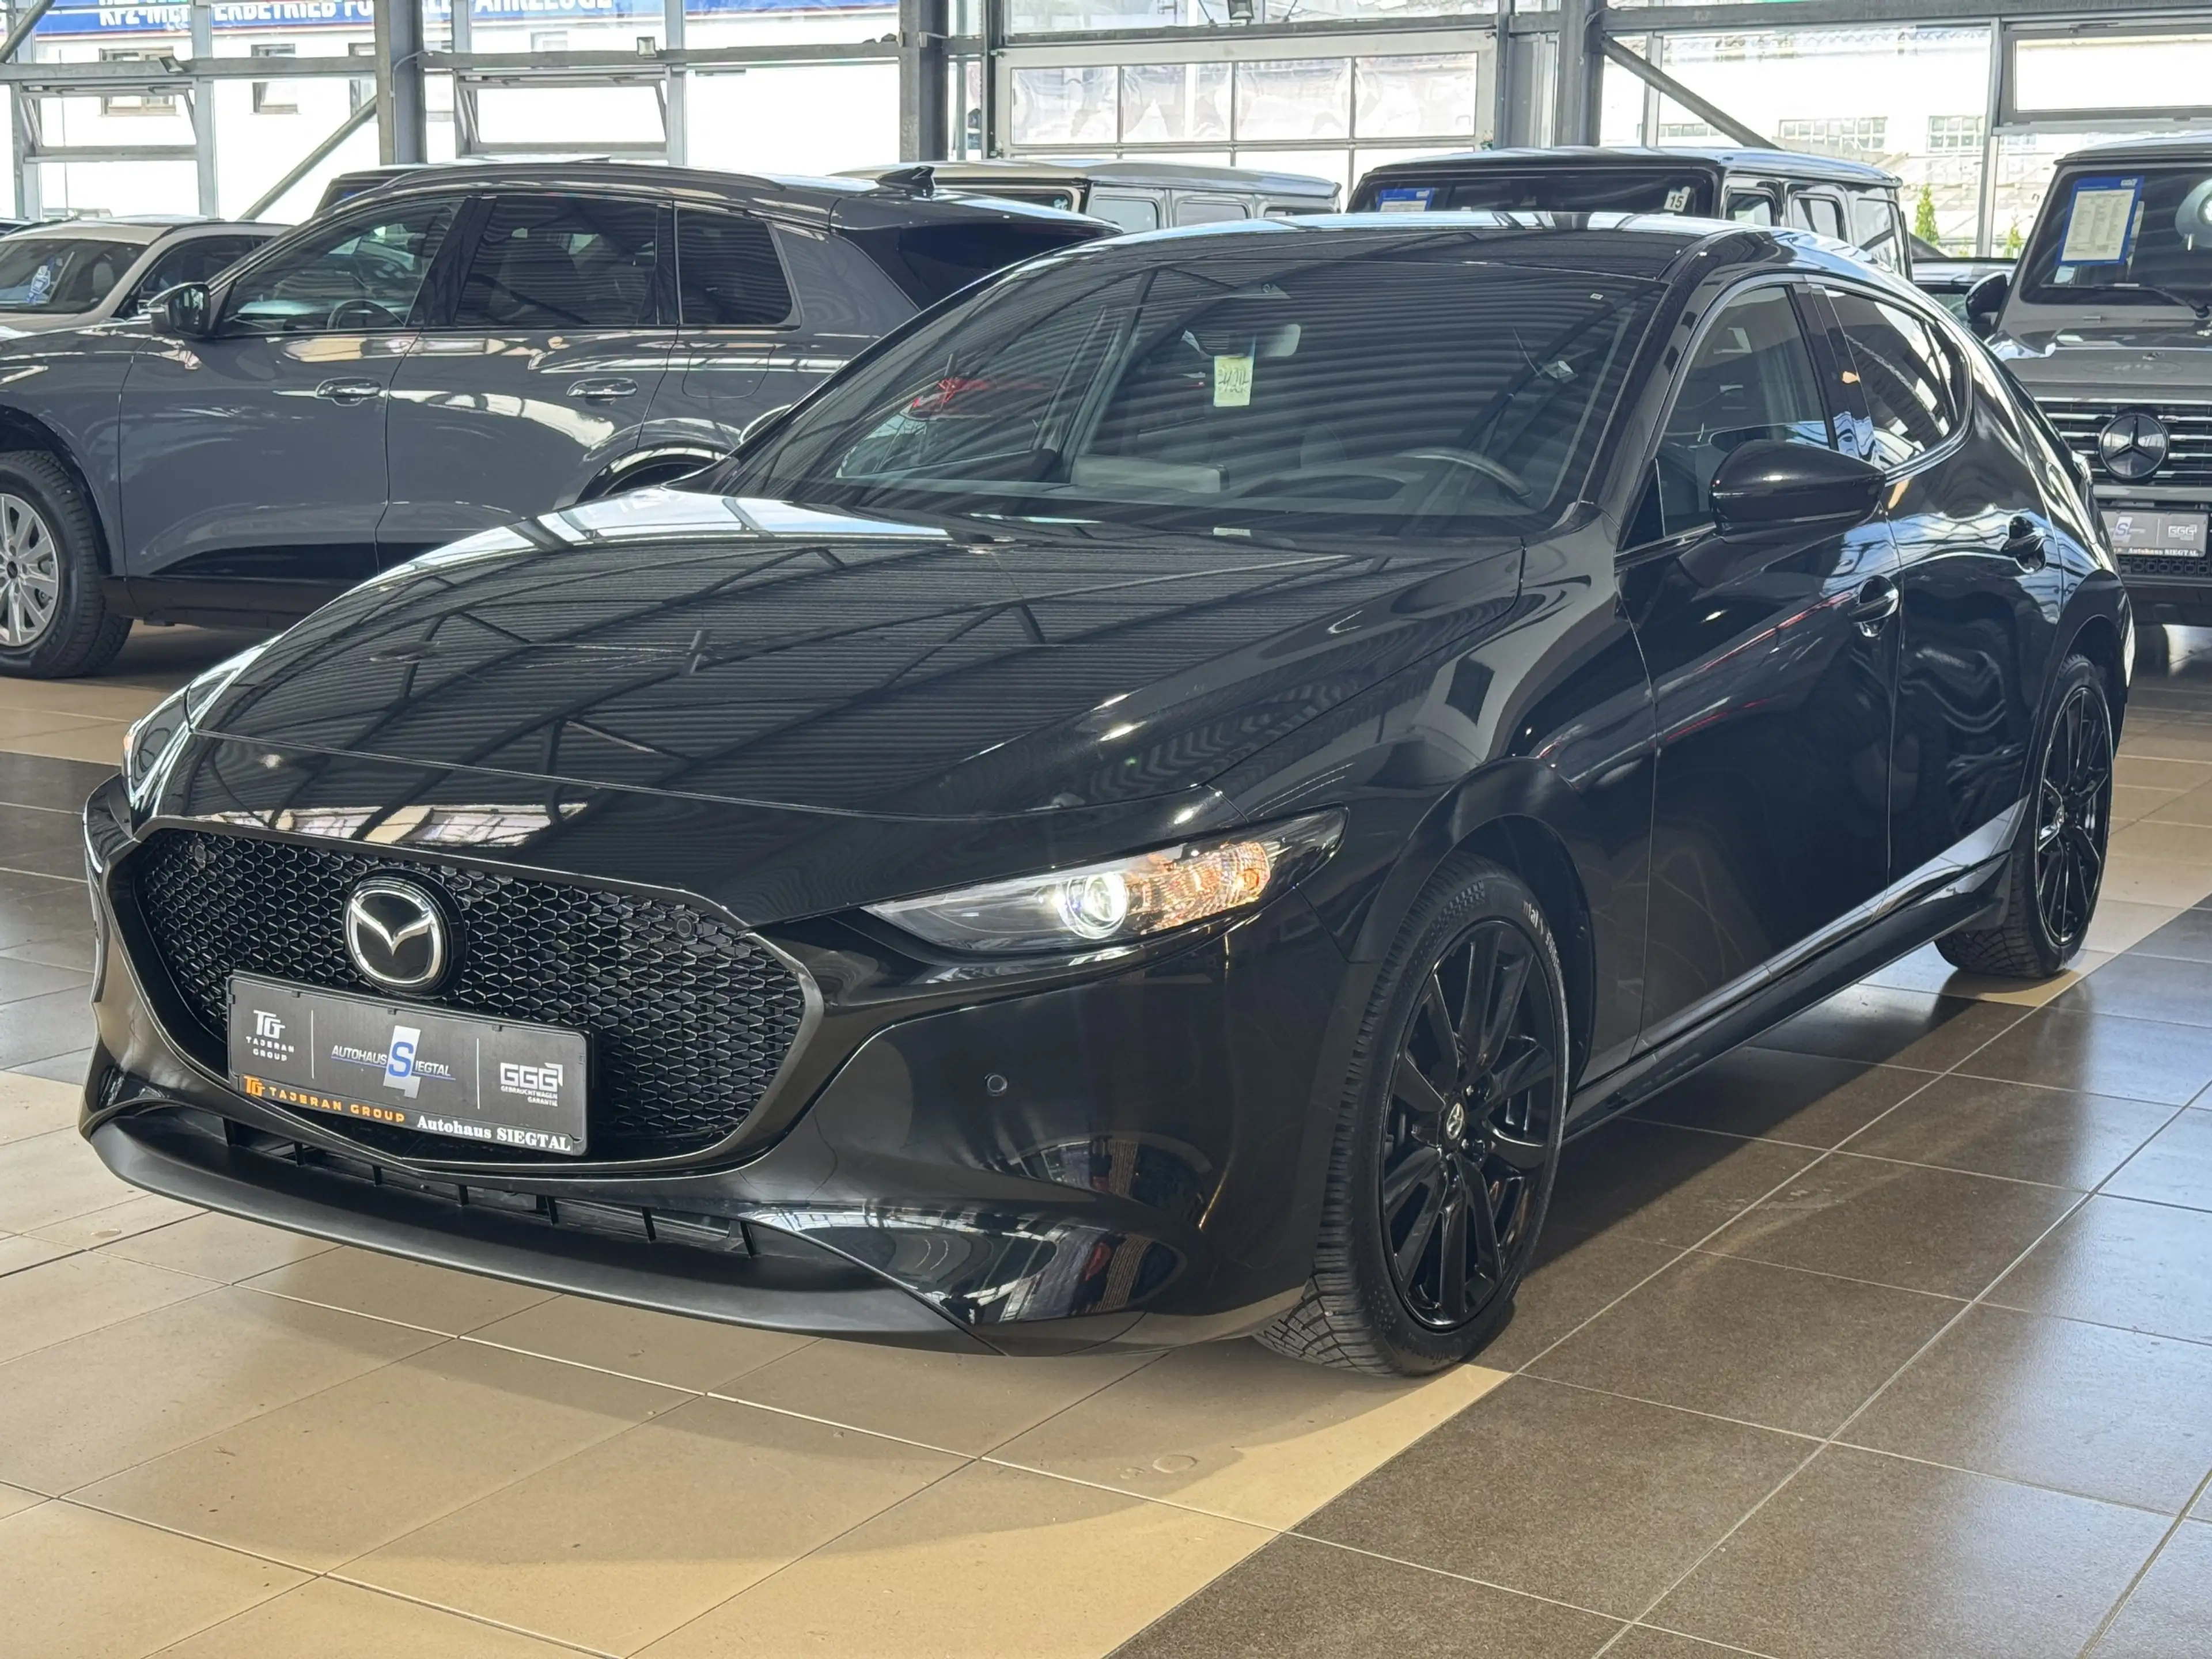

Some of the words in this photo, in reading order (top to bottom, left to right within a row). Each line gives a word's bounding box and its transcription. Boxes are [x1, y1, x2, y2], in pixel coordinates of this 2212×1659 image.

[1670, 195, 1684, 209] 15
[245, 1036, 294, 1053] TAJERAN
[253, 1048, 287, 1061] GROUP
[331, 1045, 388, 1065] AUTOHAUS
[500, 1062, 558, 1092] GGG
[269, 1086, 342, 1112] TAJERAN
[350, 1104, 406, 1123] GROUP
[527, 1096, 558, 1107] GARANTIE
[417, 1115, 491, 1139] Autohaus
[497, 1127, 570, 1152] SIEGTAL
